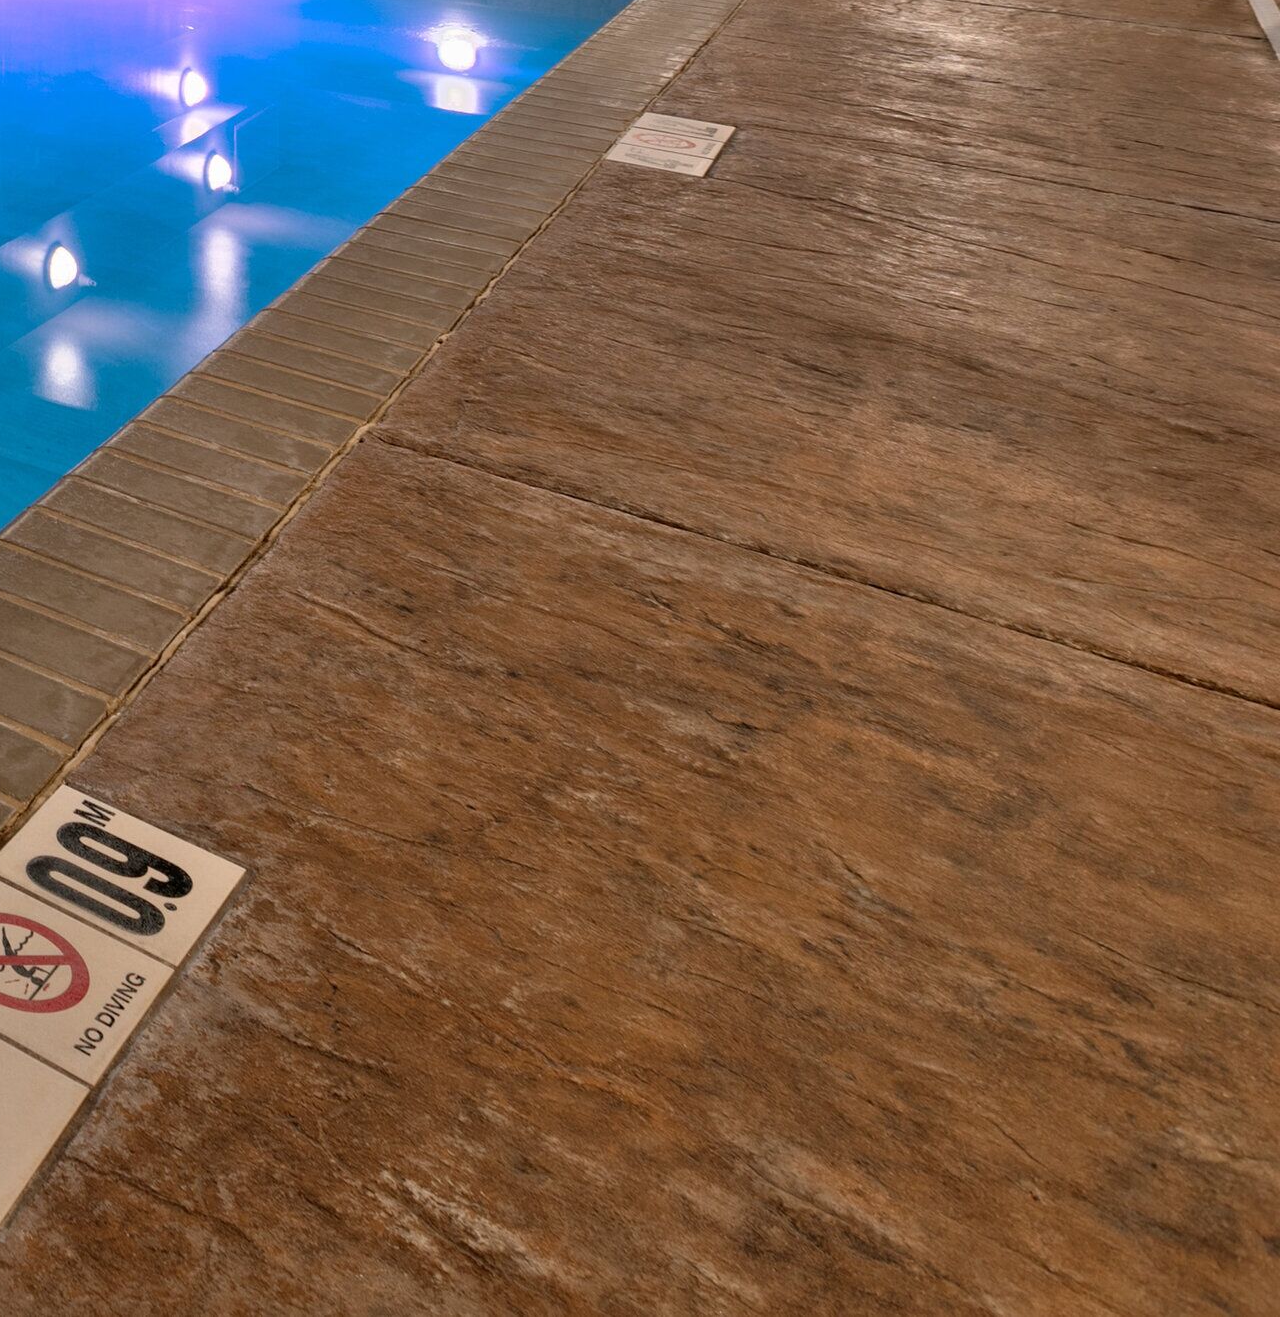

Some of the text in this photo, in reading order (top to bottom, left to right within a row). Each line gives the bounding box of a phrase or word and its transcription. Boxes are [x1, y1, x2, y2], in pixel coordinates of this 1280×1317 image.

[73, 798, 117, 828] M
[74, 971, 147, 1057] NO DIVING
